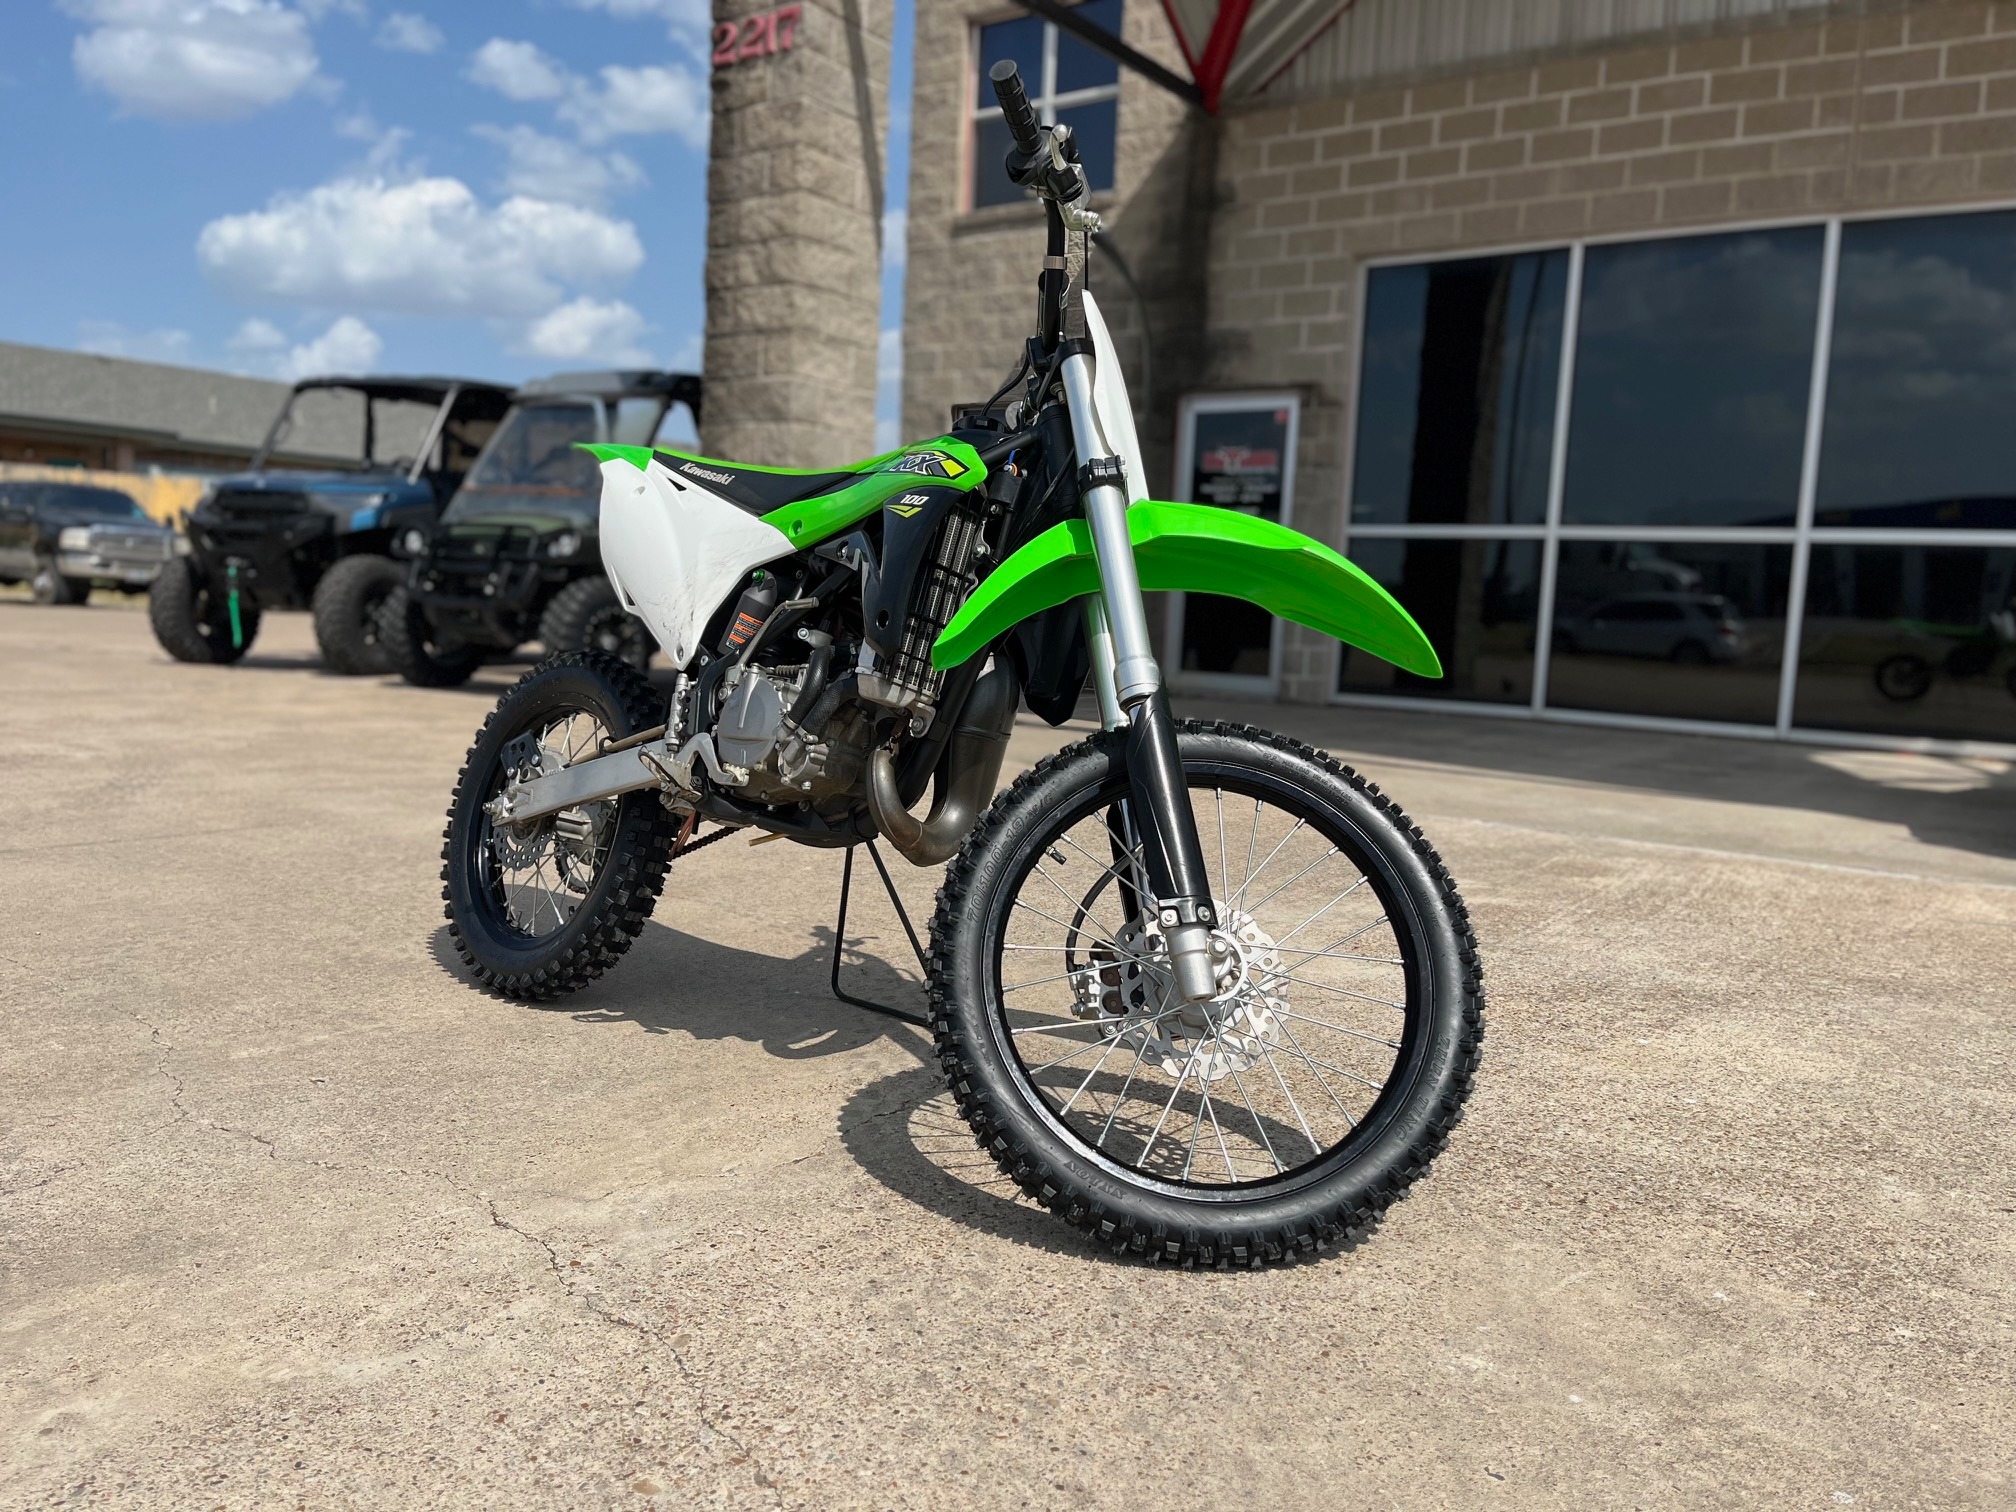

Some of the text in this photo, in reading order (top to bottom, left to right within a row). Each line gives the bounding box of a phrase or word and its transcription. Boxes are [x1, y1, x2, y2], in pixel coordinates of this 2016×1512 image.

[712, 4, 803, 66] 2217
[679, 462, 736, 485] Kawasaki
[900, 494, 930, 505] 100
[967, 817, 1025, 923] 70/100-19
[1395, 1094, 1430, 1142] TING
